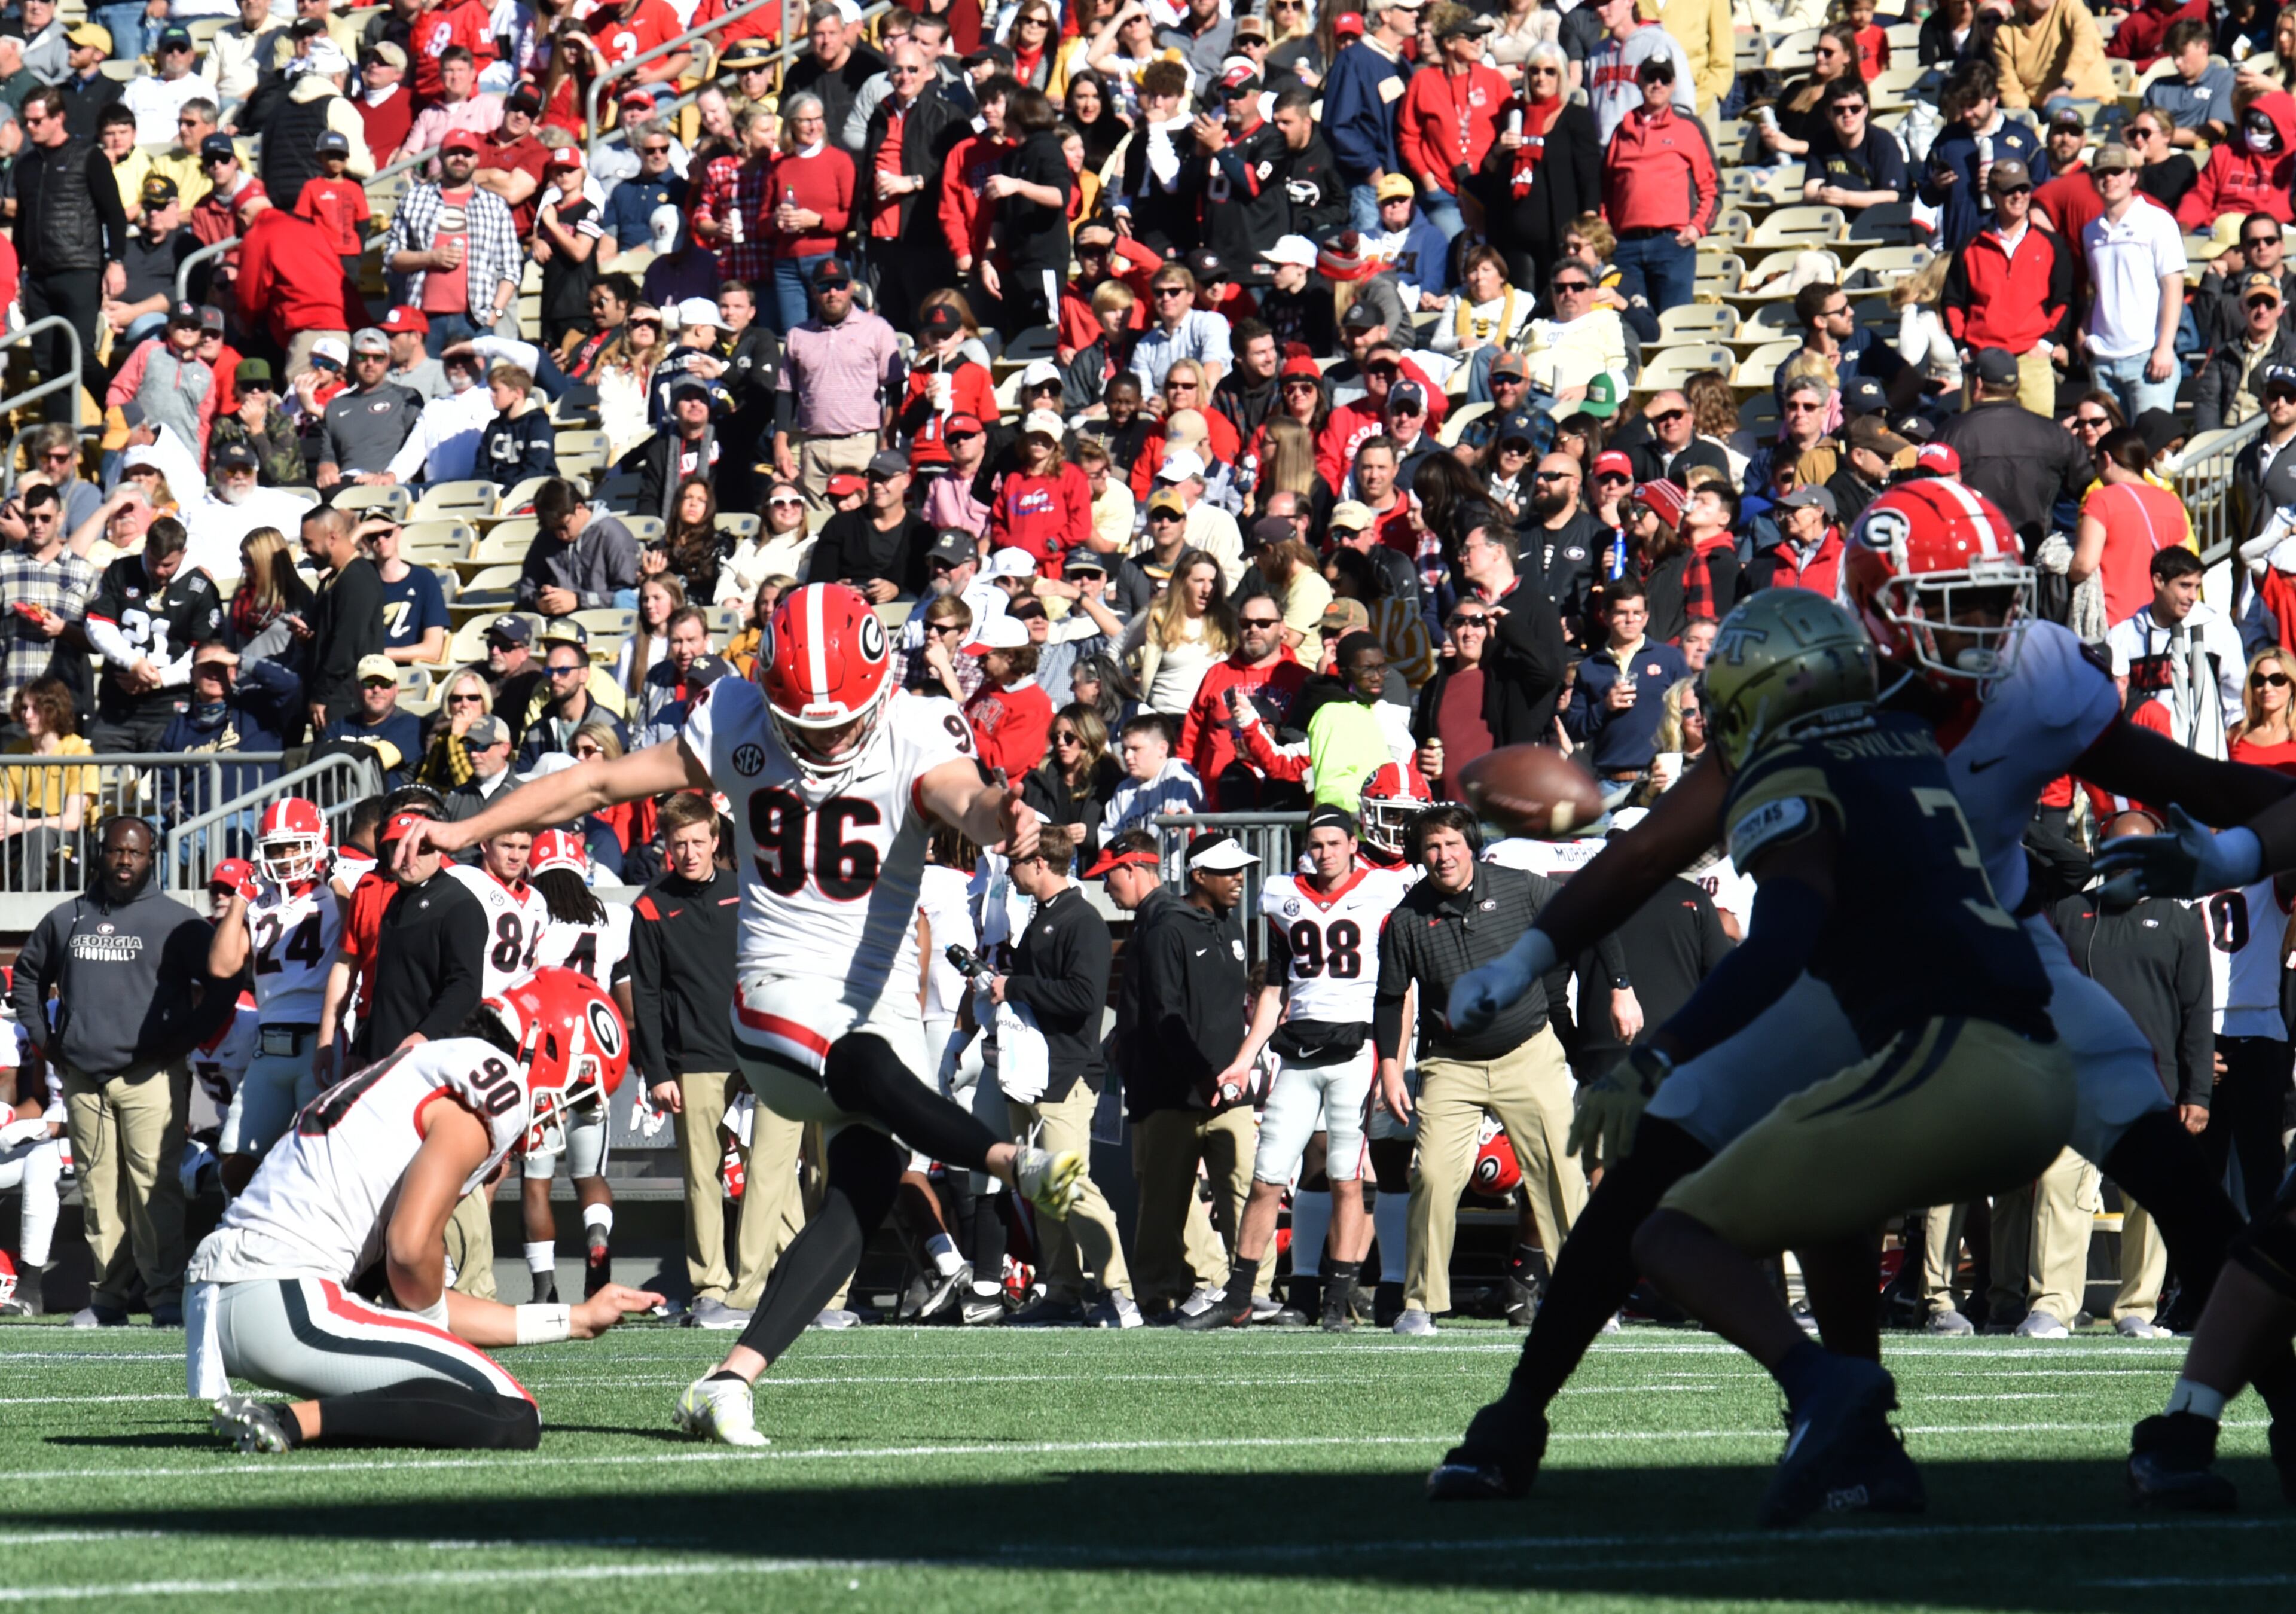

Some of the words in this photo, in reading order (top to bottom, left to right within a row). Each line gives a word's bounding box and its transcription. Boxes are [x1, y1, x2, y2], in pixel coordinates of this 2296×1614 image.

[735, 749, 762, 772] SEC
[943, 714, 972, 754] 9
[748, 786, 881, 902] 96
[1910, 786, 2020, 931] 3
[69, 934, 144, 950] GEORGIA
[255, 911, 326, 976] 24
[1289, 919, 1362, 979] 98
[589, 1002, 622, 1057] G
[195, 1061, 233, 1106] 5
[469, 1057, 521, 1116] 90
